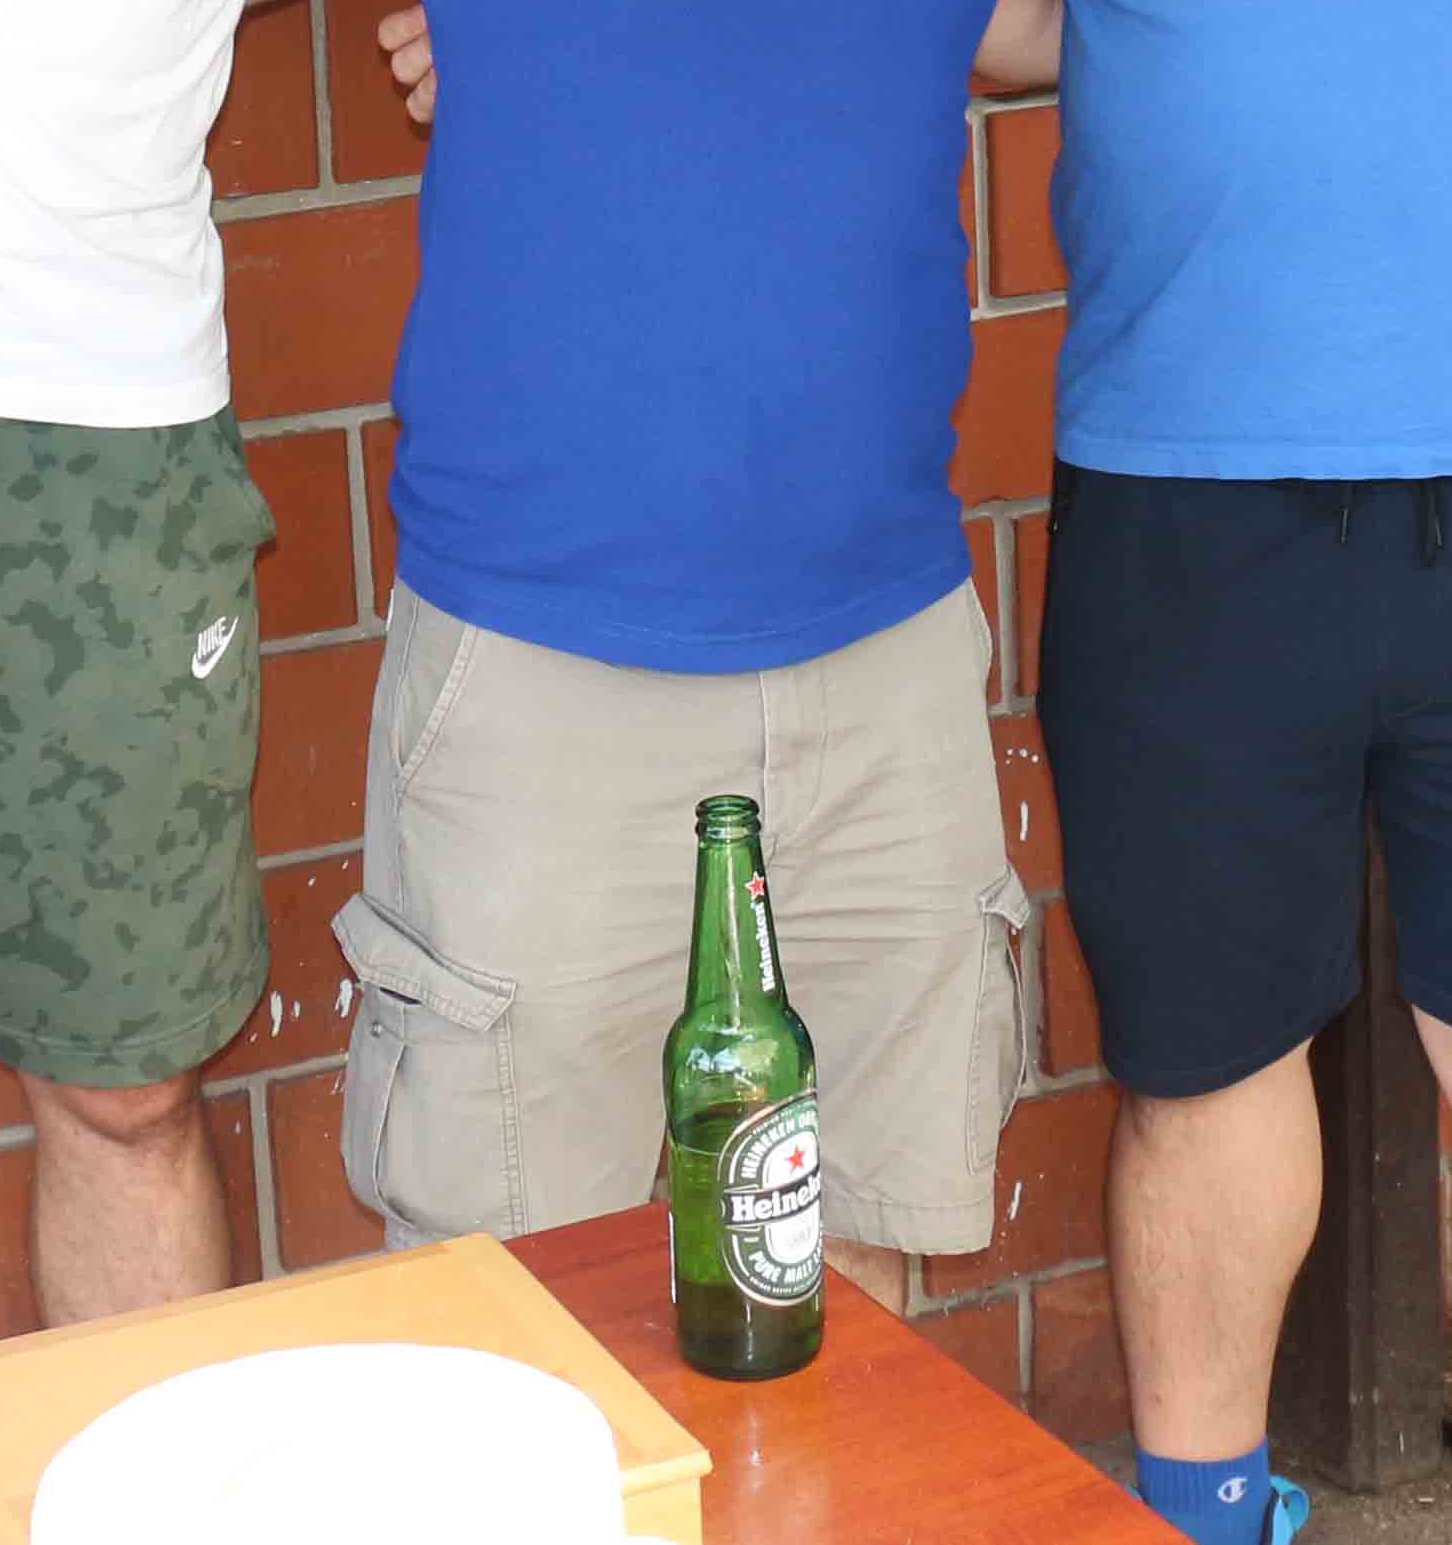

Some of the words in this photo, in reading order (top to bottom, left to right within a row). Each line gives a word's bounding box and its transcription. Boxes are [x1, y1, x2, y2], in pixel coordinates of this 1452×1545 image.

[197, 616, 227, 660] NIKE
[754, 901, 776, 992] Heineken
[731, 1172, 820, 1223] Heinek
